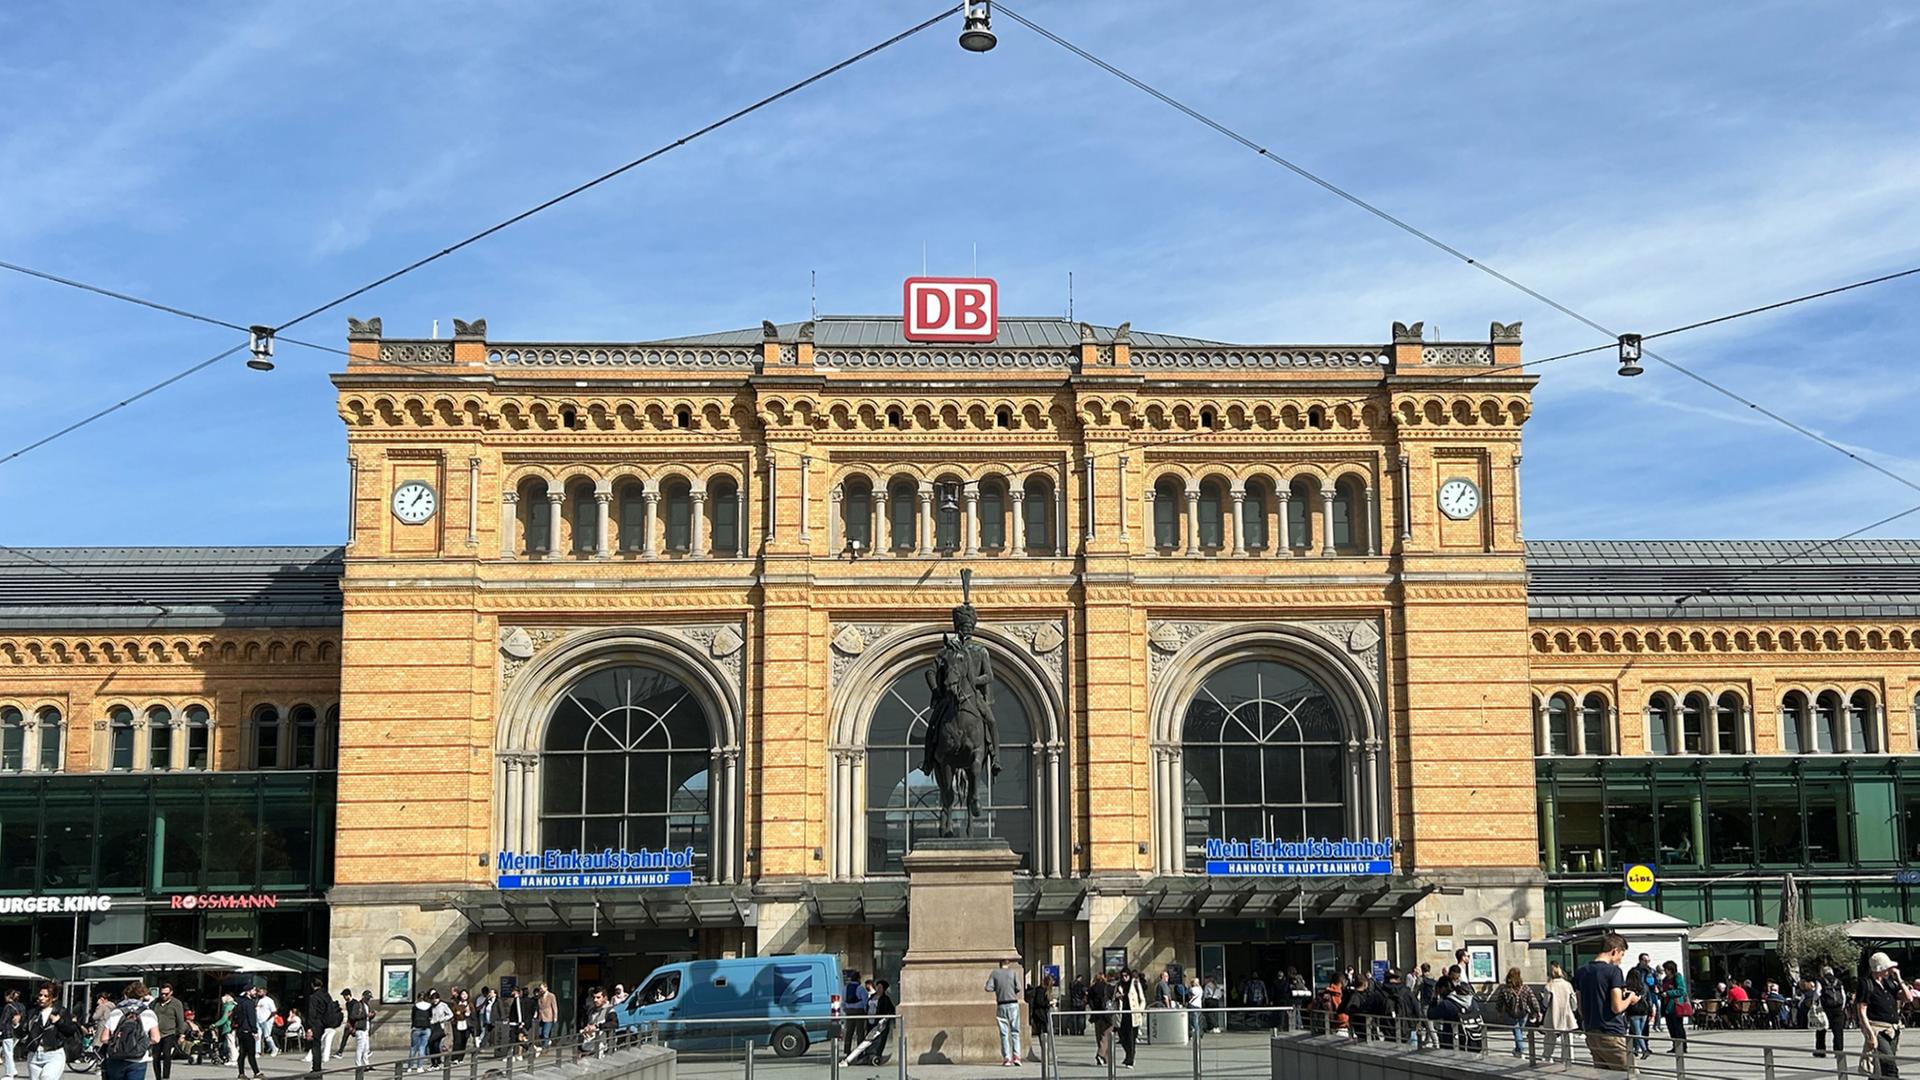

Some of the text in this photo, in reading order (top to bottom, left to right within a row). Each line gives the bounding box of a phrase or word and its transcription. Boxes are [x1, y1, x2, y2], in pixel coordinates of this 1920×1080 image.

[916, 287, 988, 330] DB
[1206, 837, 1393, 859] Mein Einkaufsbahnhof
[498, 846, 694, 870] Mein Einkaufsbahnhof
[1228, 862, 1371, 873] HANNOVER HAUPTBAHNHOF
[520, 873, 670, 887] HANNOVER HAUPTBAHNHOF
[64, 895, 112, 912] KING
[171, 894, 277, 909] ROSSMANN
